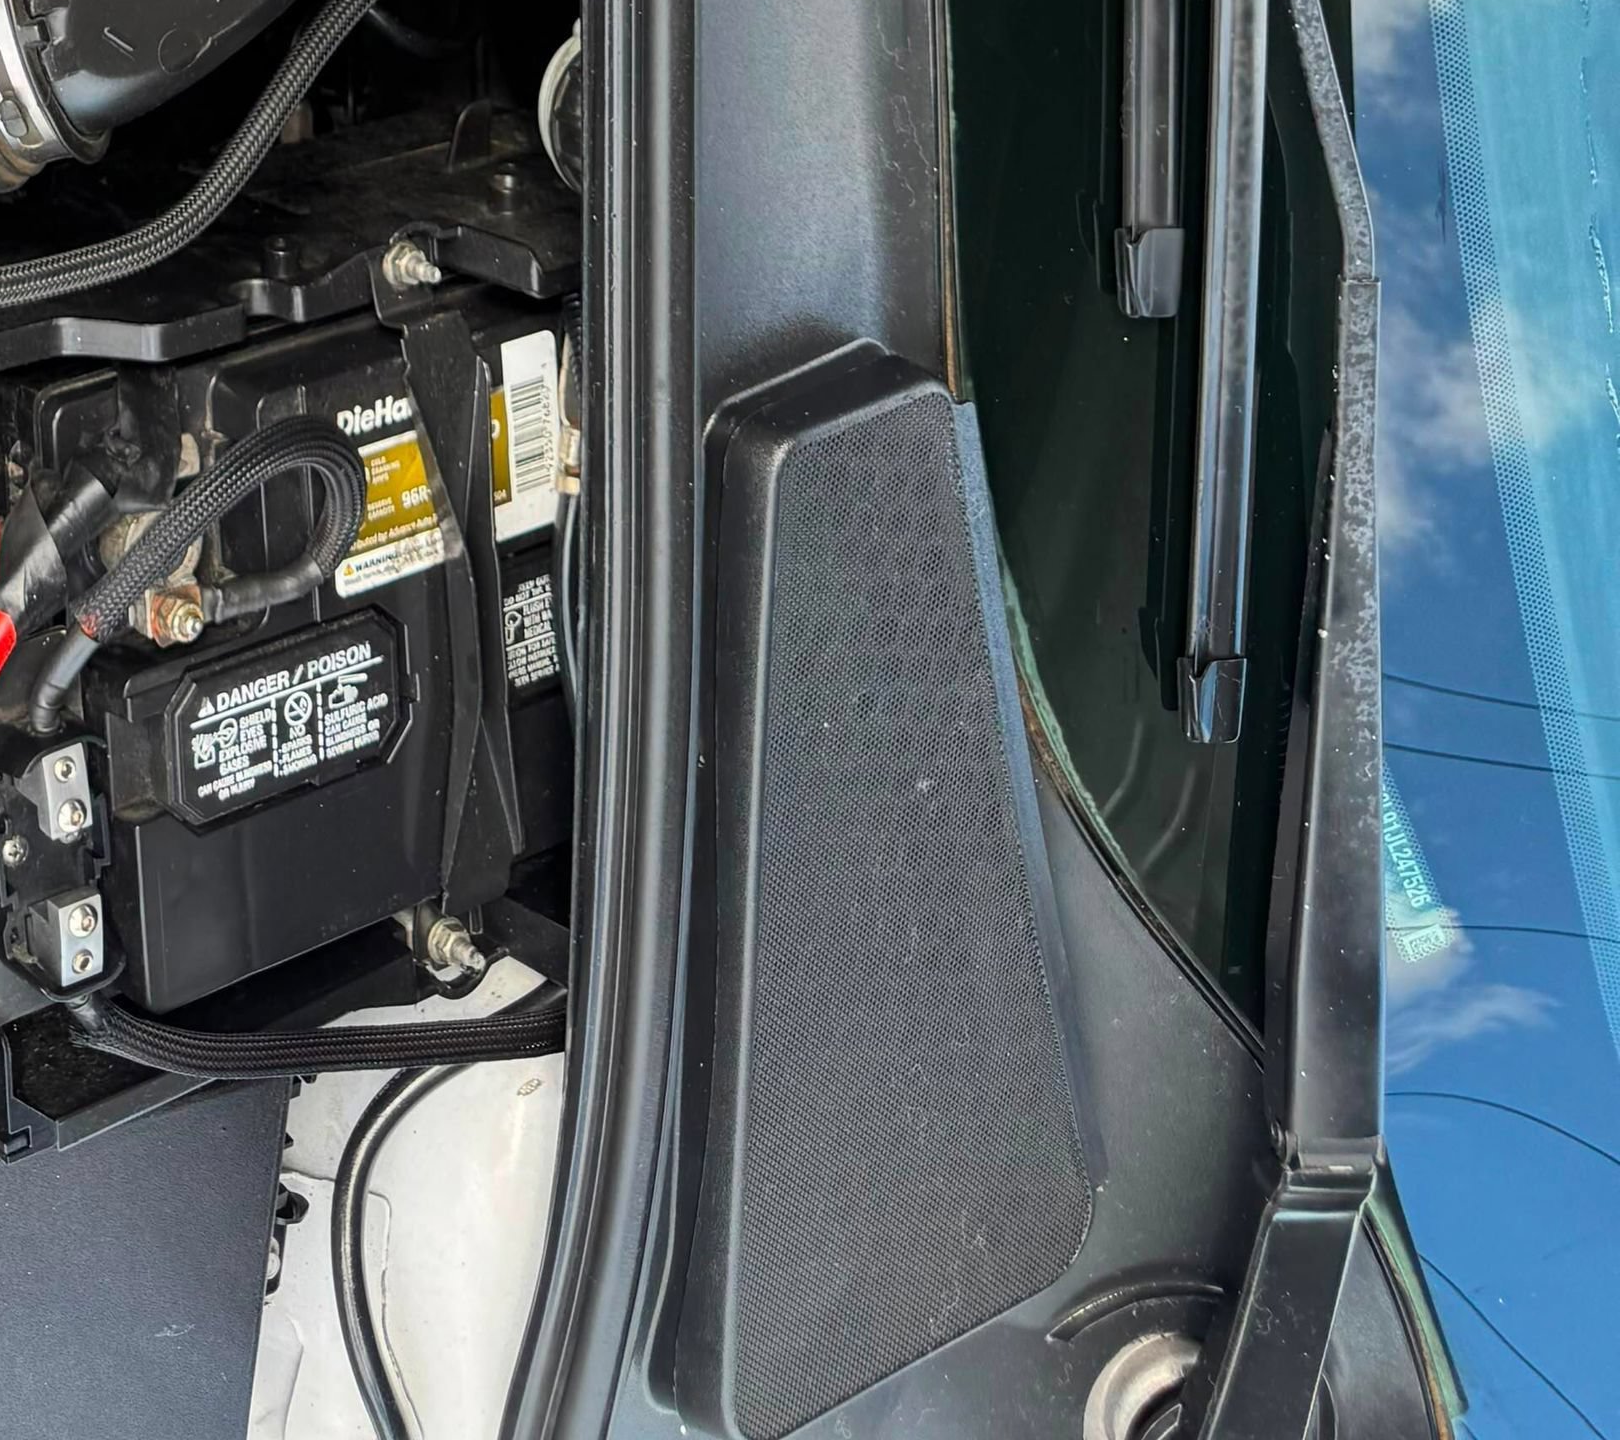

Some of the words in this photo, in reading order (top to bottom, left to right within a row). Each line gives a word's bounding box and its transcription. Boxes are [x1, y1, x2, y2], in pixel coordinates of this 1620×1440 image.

[216, 670, 291, 713] DANGER
[291, 663, 305, 686] /
[307, 640, 372, 680] POISON
[239, 707, 272, 730] SHIELD
[324, 700, 366, 727] SULFURIC
[366, 692, 389, 712] ACID
[239, 723, 264, 743] EYES
[289, 723, 306, 739] NO
[218, 734, 267, 764] EXPLOSIVE
[219, 754, 250, 777] GASES
